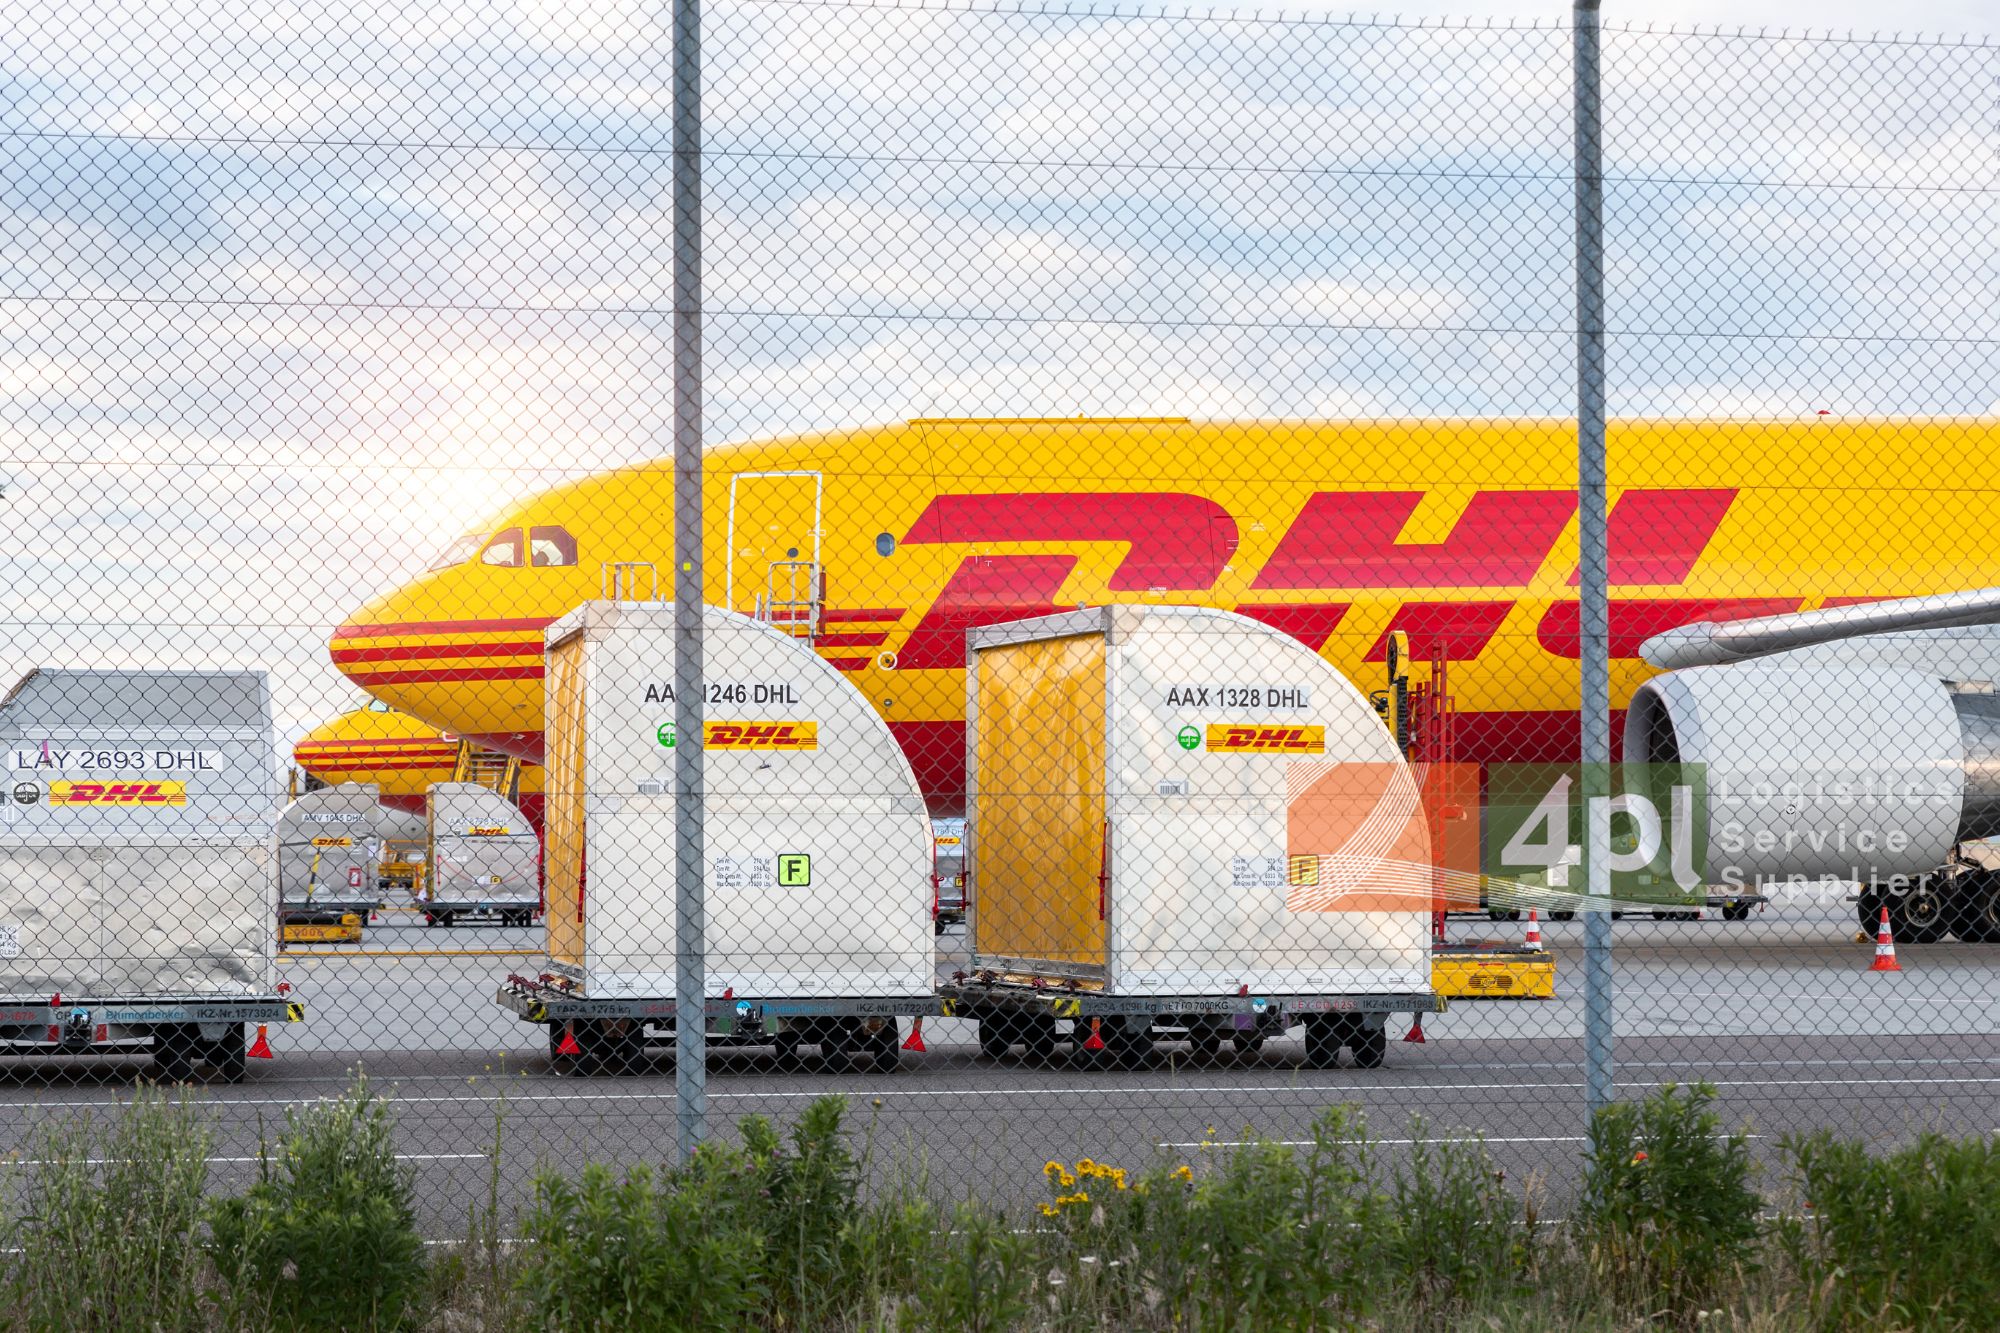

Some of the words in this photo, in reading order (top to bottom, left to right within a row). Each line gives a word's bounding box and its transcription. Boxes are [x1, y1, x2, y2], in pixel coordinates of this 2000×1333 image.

[895, 487, 1806, 670] DHL
[644, 683, 676, 703] AA
[703, 684, 747, 704] 1246
[754, 684, 799, 704] DHL
[1166, 687, 1209, 707] AAX
[1216, 688, 1261, 708] 1328
[1267, 689, 1308, 708] DHL
[708, 725, 801, 745] DHL
[1225, 728, 1309, 748] DHL
[18, 750, 71, 769] LAY
[80, 751, 146, 770] 2693
[156, 751, 214, 770] DHL
[67, 784, 169, 802] DHL
[787, 859, 802, 882] F
[1298, 859, 1312, 880] F
[1145, 1002, 1157, 1013] kg
